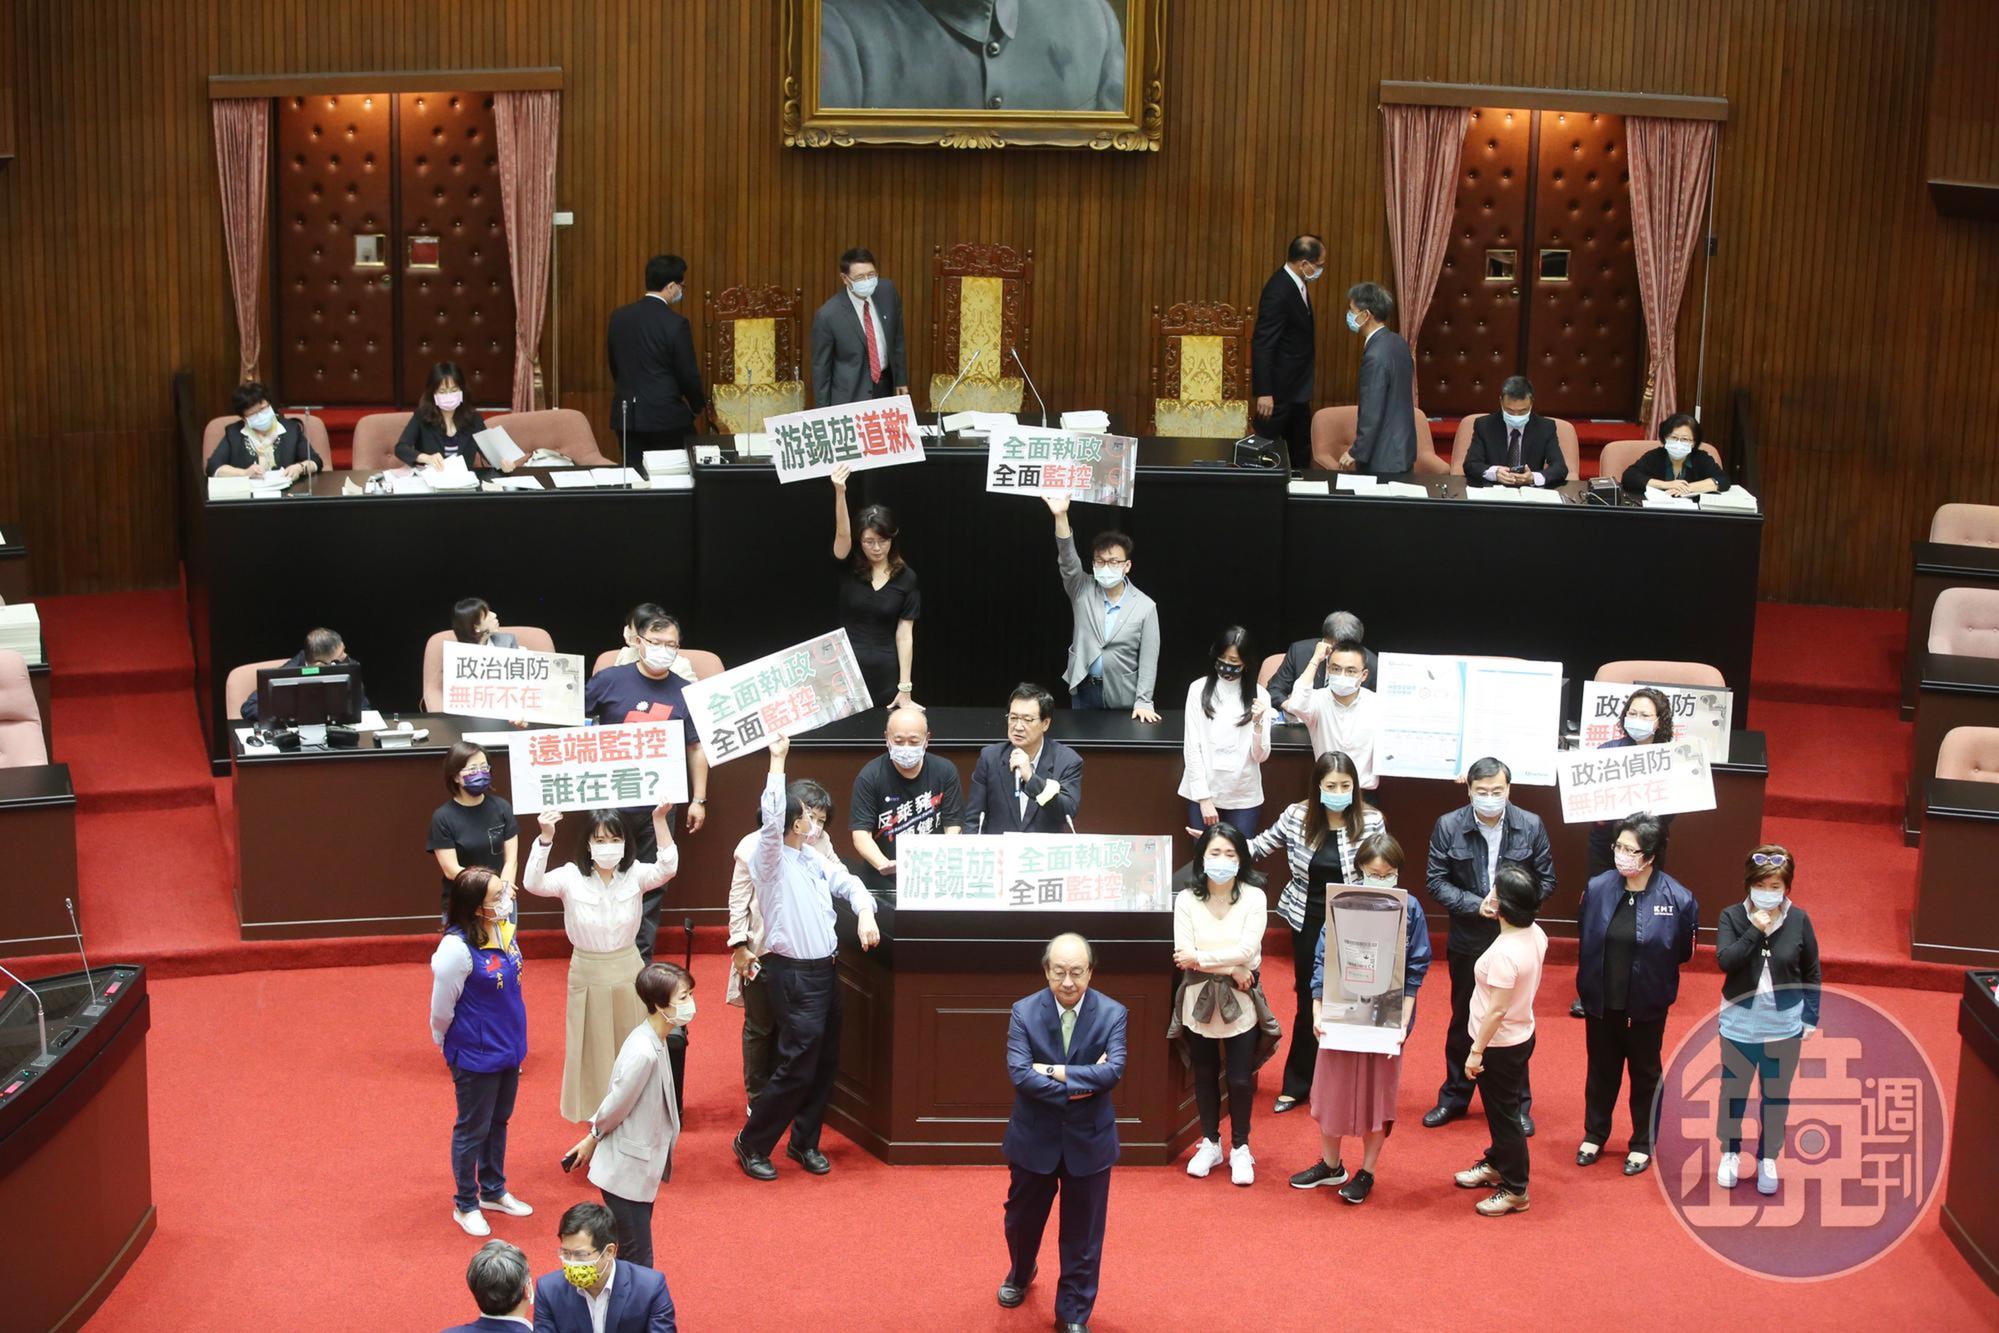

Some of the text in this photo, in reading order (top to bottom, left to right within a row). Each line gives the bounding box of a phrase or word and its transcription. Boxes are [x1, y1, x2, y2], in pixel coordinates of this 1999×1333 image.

[775, 408, 915, 470] 游錫堃道歉
[1002, 436, 1103, 462] 全面執政
[993, 464, 1093, 488] 全面監控
[456, 657, 549, 680] 政治偵防
[449, 686, 542, 708] 無所不在
[707, 652, 816, 724] 全面執政
[1595, 694, 1696, 717] 政防
[711, 685, 820, 759] 全面監控
[529, 727, 667, 766] 遠端監控
[1571, 748, 1671, 787] 政治偵防
[1568, 780, 1669, 816] 無所不在
[903, 847, 1004, 899] 游錫堃
[1018, 840, 1132, 874] 全面執政
[1009, 872, 1122, 906] 全面監控
